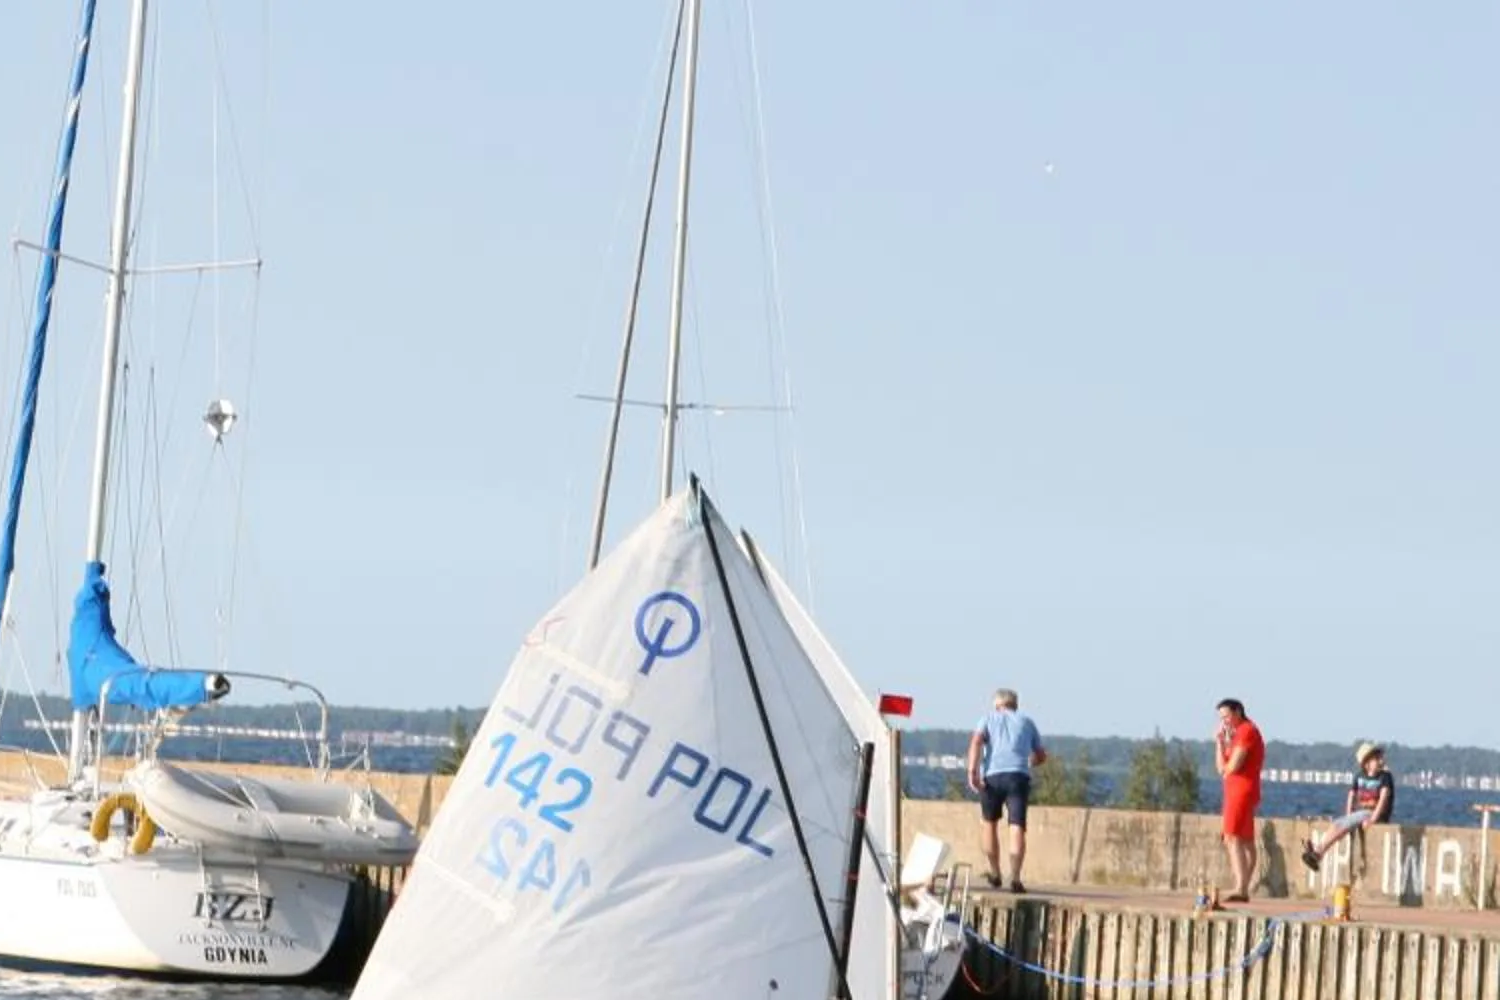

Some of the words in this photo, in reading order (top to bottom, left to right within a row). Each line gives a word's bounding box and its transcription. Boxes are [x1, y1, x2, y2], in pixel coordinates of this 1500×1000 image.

[484, 732, 594, 833] 142
[647, 742, 776, 857] POL
[203, 946, 268, 964] GDYNIA
